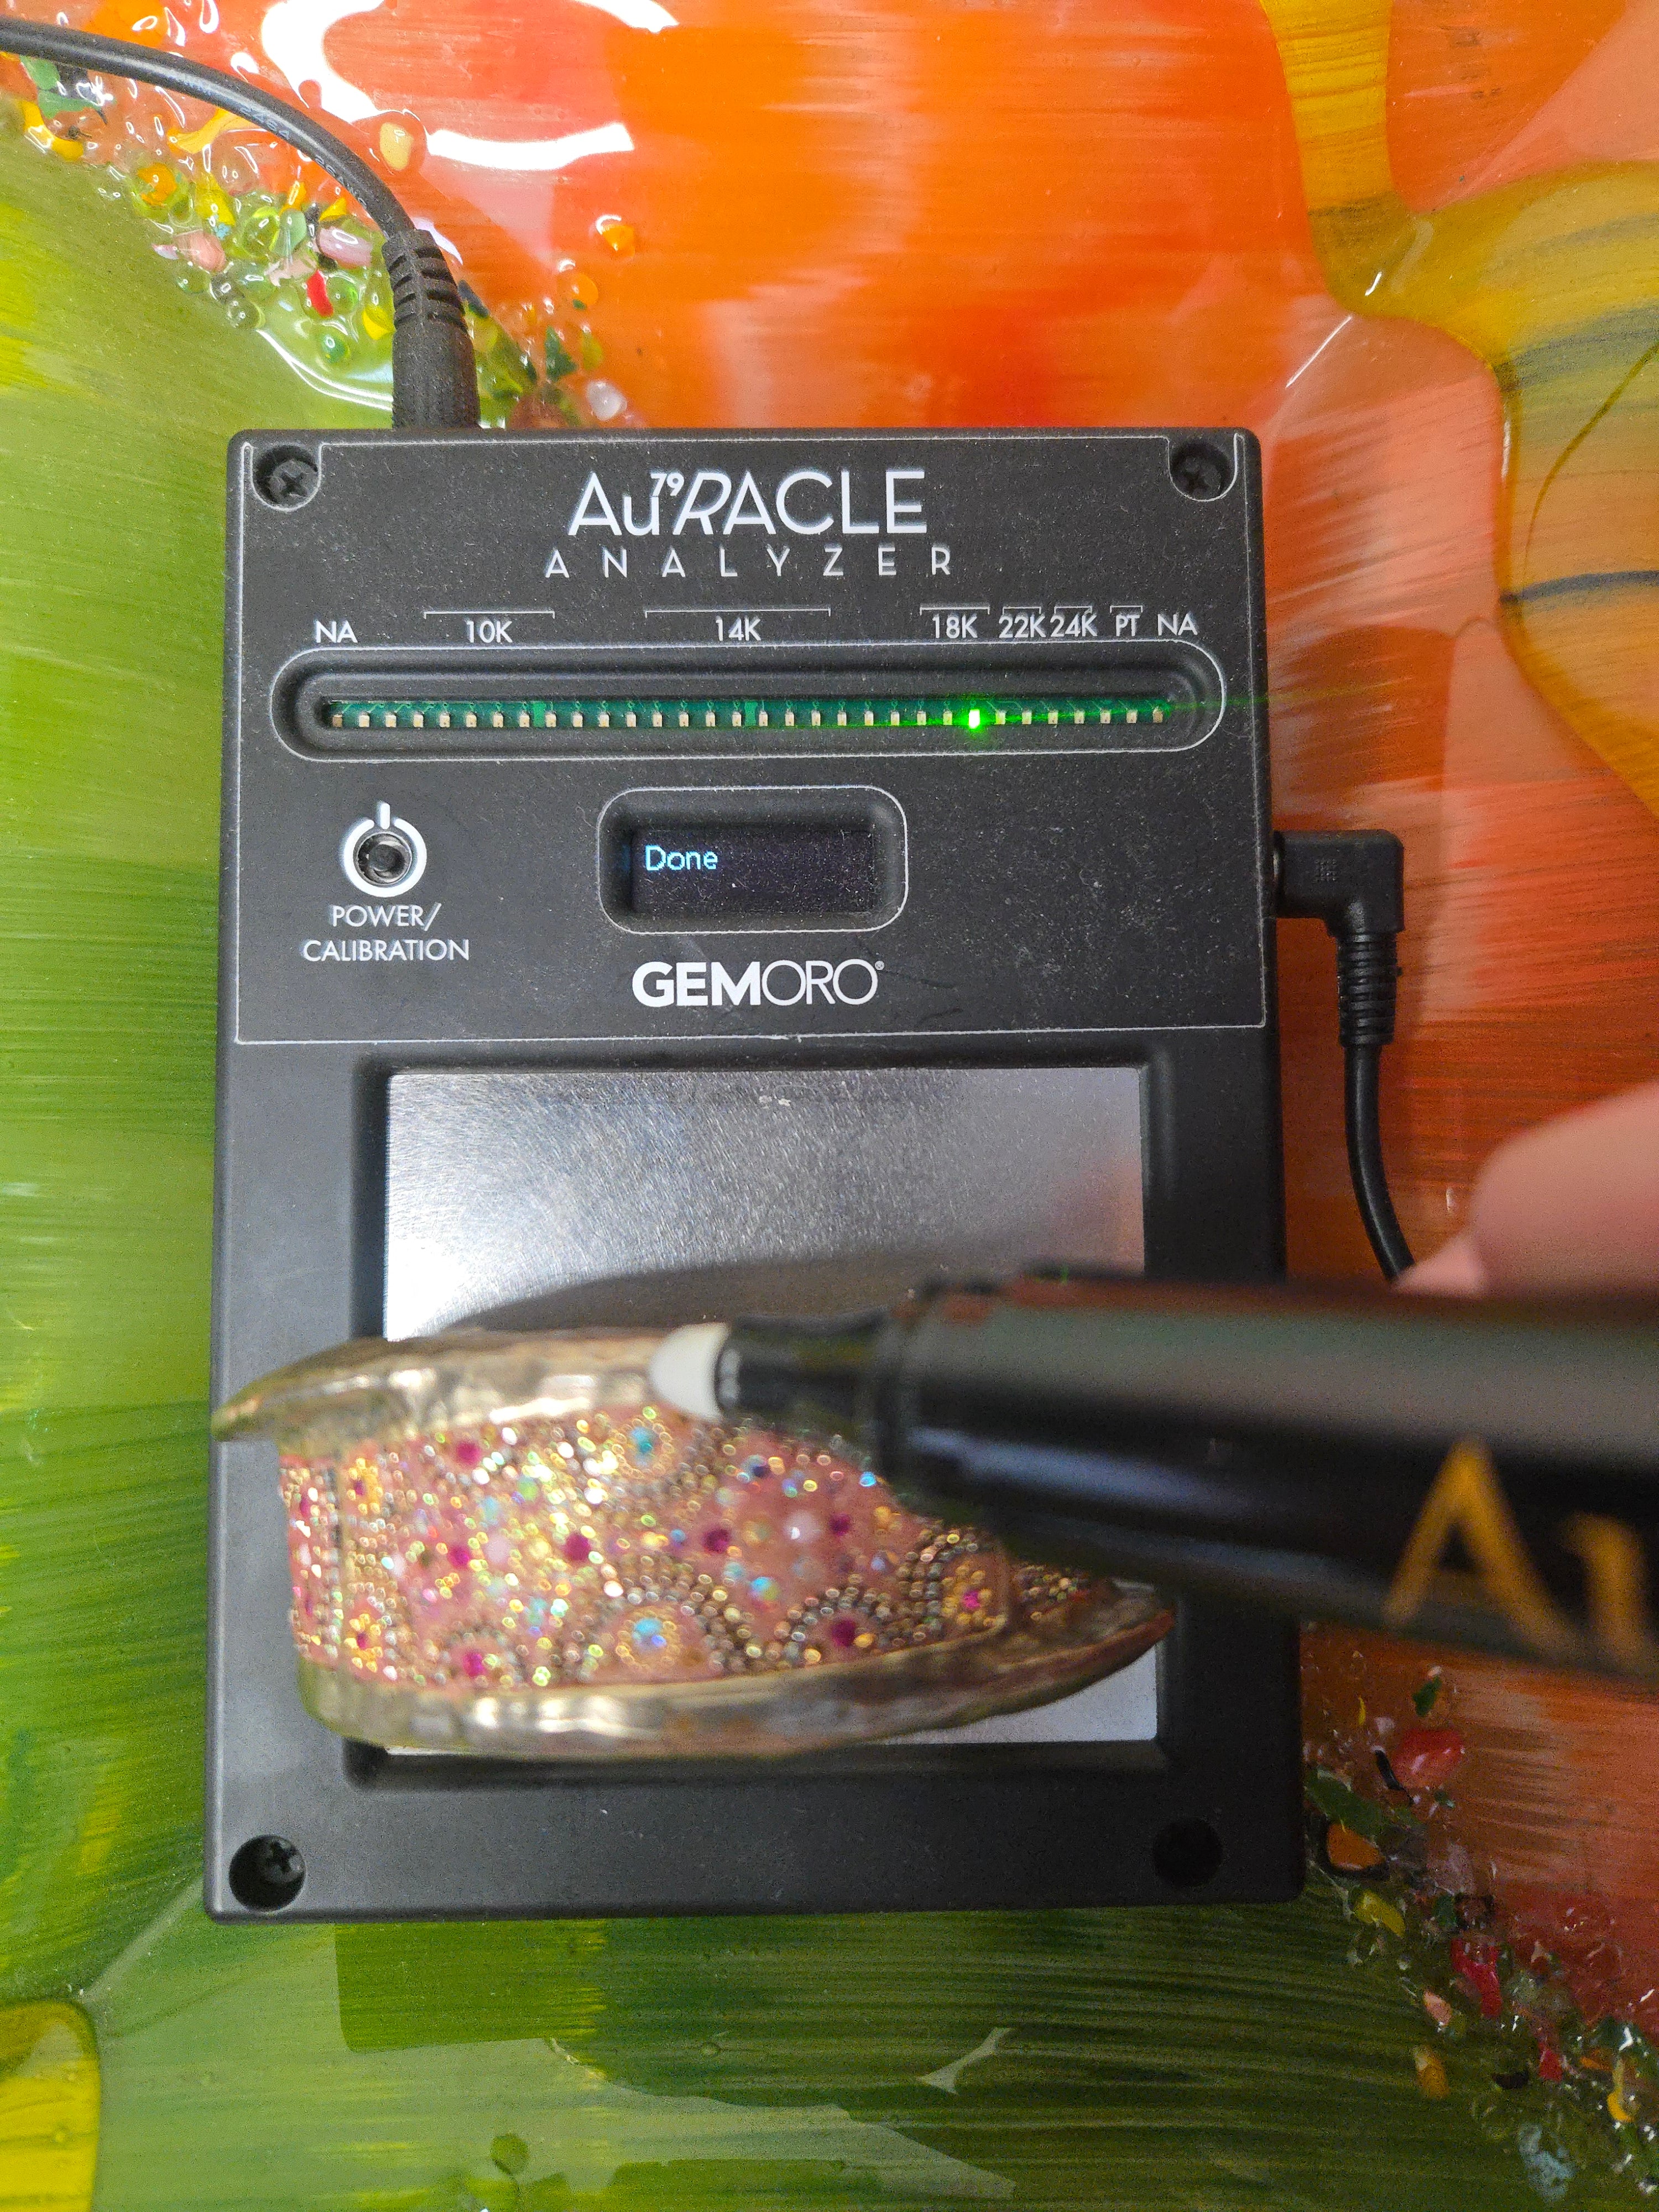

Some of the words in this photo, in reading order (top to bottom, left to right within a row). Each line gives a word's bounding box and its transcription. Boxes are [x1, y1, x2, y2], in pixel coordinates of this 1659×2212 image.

[545, 546, 952, 579] ANALYZER
[314, 620, 358, 644] NA
[466, 620, 513, 644] 10K
[716, 618, 761, 641] 14K
[932, 615, 978, 639] 18K
[999, 614, 1046, 638] 22K
[1051, 614, 1097, 637] 24K
[1116, 614, 1140, 637] PT
[1158, 613, 1198, 635] NA
[645, 844, 718, 872] Done
[331, 902, 442, 931] POWER/
[302, 939, 470, 962] CALIBRATION
